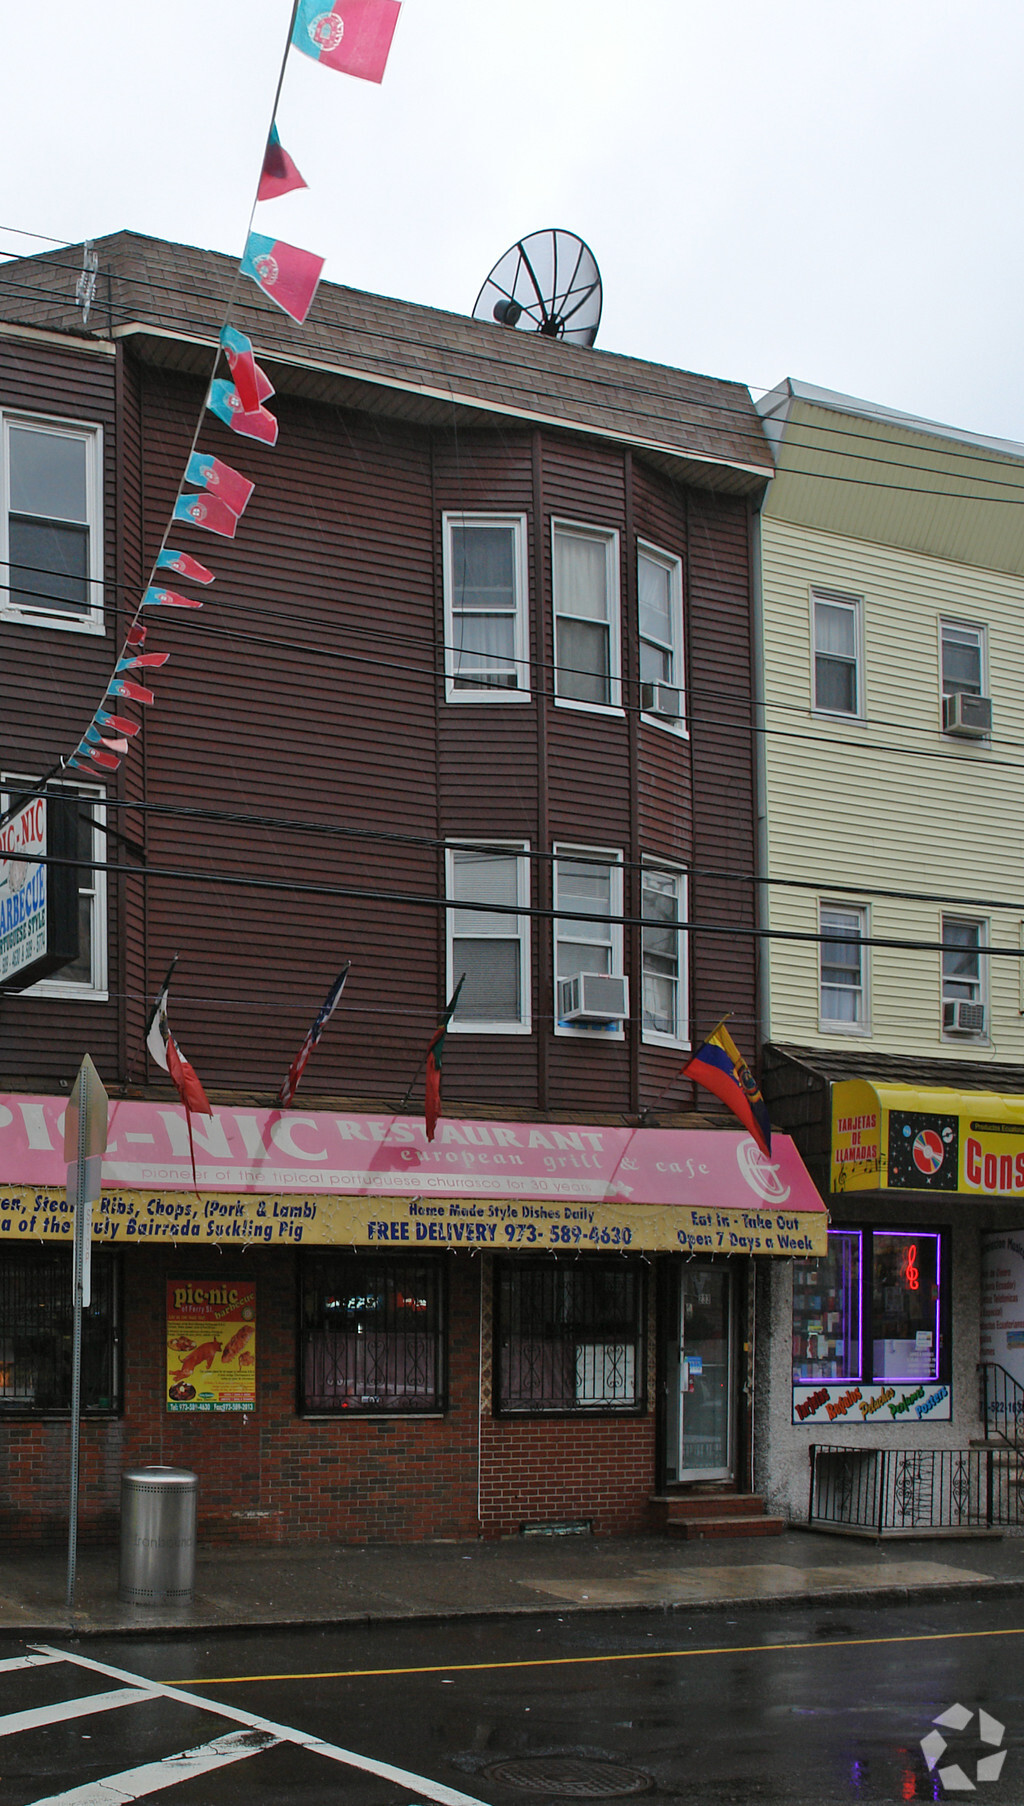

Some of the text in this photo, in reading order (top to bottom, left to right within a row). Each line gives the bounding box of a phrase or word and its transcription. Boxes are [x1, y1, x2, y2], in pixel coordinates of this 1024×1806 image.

[28, 909, 46, 935] STYLE
[837, 1114, 877, 1133] TARJETAS
[335, 1120, 605, 1151] RESTAURANT
[851, 1131, 861, 1146] DE
[400, 1149, 711, 1179] european grill & cafe
[835, 1145, 877, 1163] LLAMADAS
[141, 1168, 592, 1194] pioneer of the tipical portuguese churrasco for 30 years
[100, 1197, 140, 1218] Ribs,
[147, 1199, 198, 1220] Chops,
[204, 1200, 244, 1219] (Pork
[256, 1201, 267, 1218] &
[272, 1201, 317, 1220] Lamb)
[409, 1203, 594, 1223] Home Made Style Dishes Daily
[18, 1213, 37, 1233] of
[43, 1213, 72, 1234] the
[126, 1218, 200, 1238] Bairrada
[206, 1220, 273, 1242] Suckling
[278, 1221, 303, 1242] Pig
[367, 1221, 409, 1241] FREE
[416, 1222, 497, 1242] DELIVERY
[690, 1211, 712, 1227] Eat
[715, 1212, 730, 1227] in
[741, 1213, 773, 1229] Take
[776, 1215, 799, 1230] Out
[677, 1229, 813, 1251] Open 7 Days a Week
[914, 1385, 949, 1420] Posters
